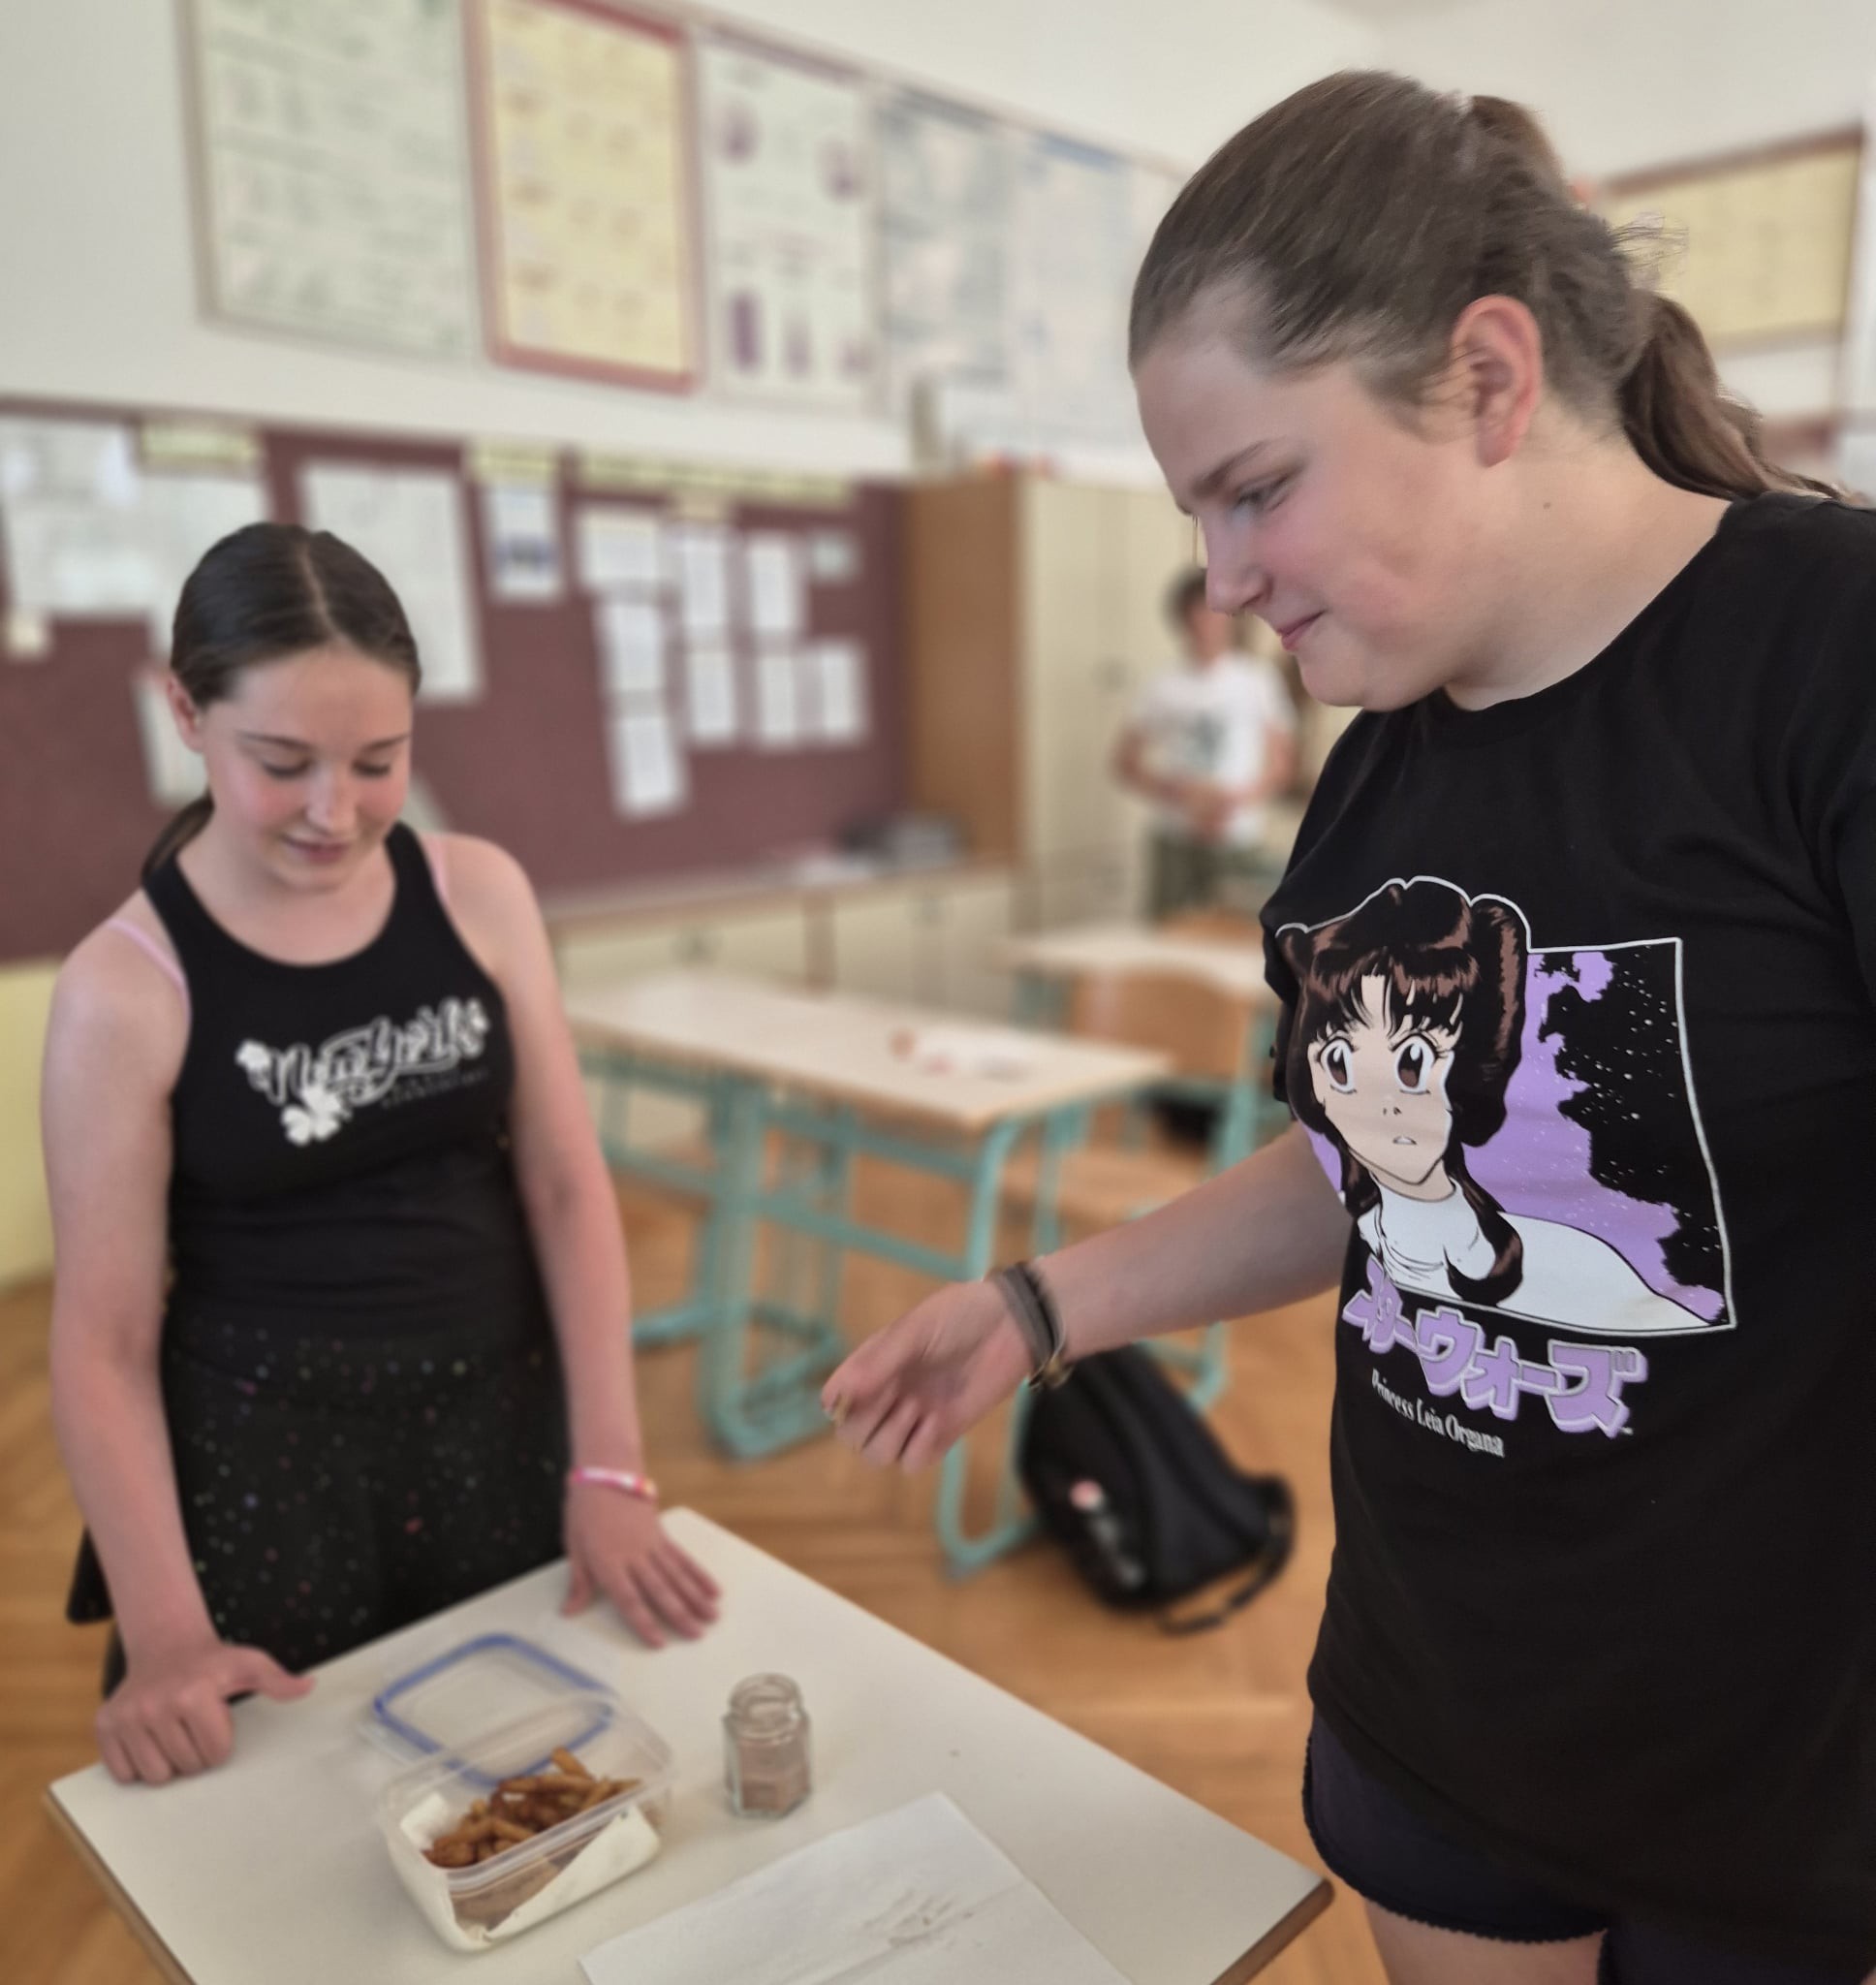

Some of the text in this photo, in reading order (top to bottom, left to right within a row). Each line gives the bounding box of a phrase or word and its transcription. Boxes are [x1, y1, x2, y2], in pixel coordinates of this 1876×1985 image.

[1371, 1367, 1506, 1460] Princess Leia Organa
